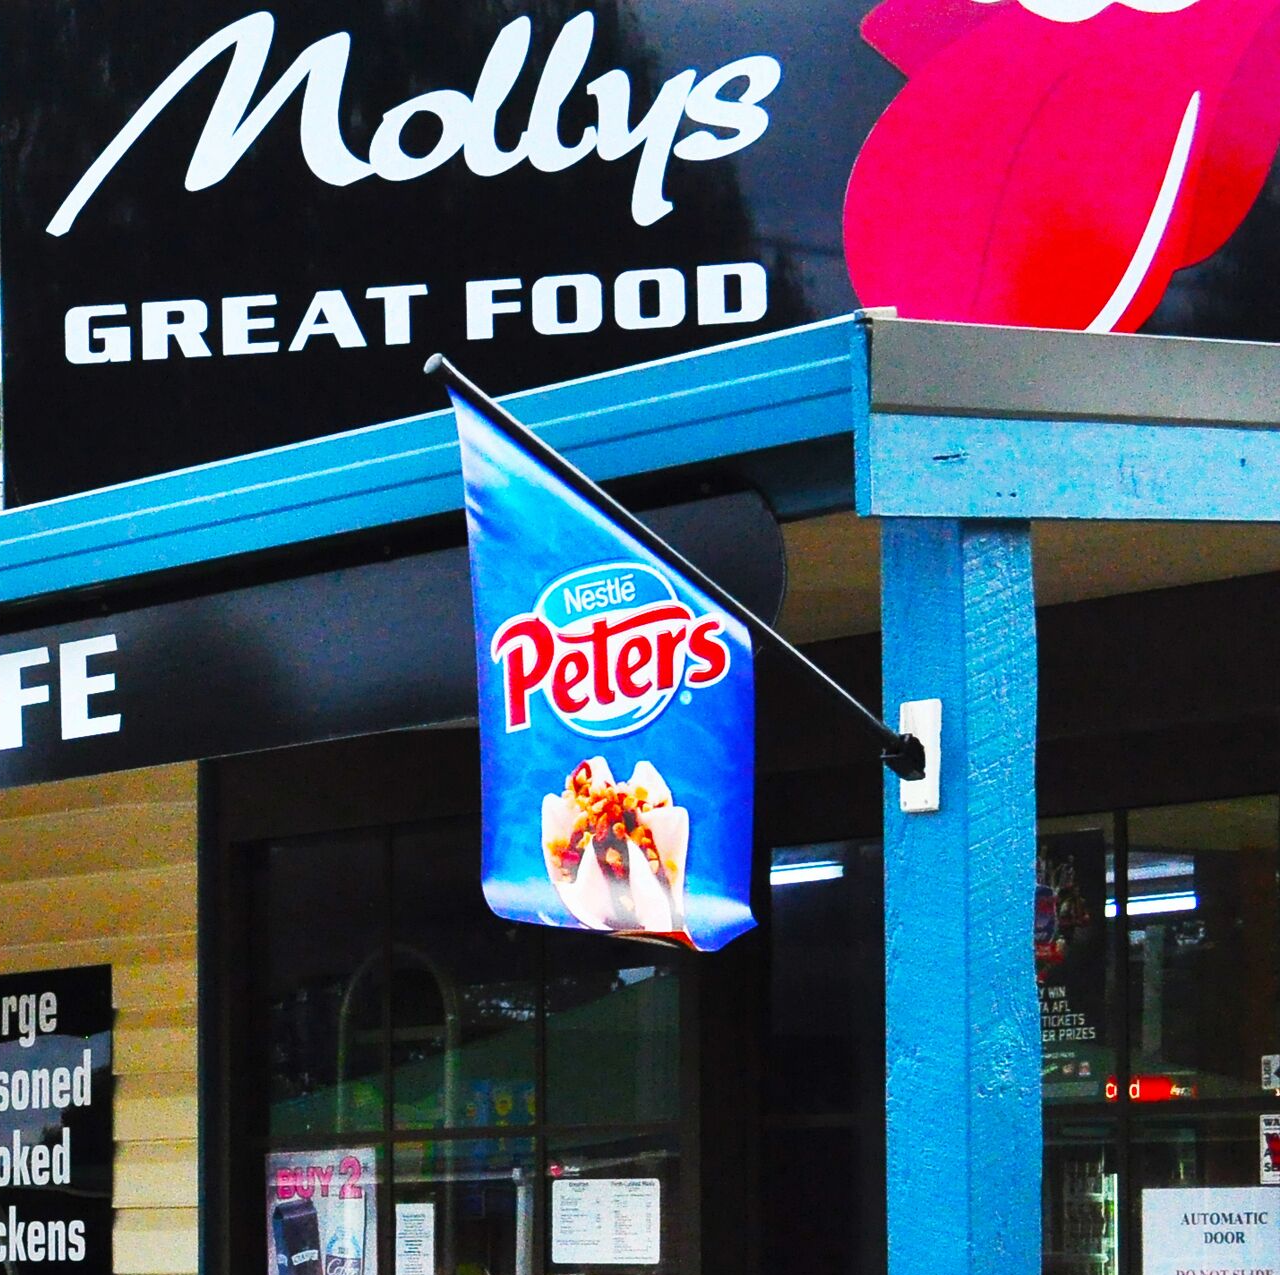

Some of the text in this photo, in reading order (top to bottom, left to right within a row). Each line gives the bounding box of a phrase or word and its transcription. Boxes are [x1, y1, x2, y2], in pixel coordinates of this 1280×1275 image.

[45, 10, 783, 238] Mollys
[64, 261, 769, 365] GREAT FOOD
[492, 603, 730, 732] Peters
[1048, 986, 1066, 998] WIN
[1052, 1000, 1071, 1012] AFL
[1041, 1013, 1085, 1027] TICKETS
[1059, 1027, 1096, 1040] PRIZES
[275, 1165, 335, 1200] BUY
[1180, 1211, 1269, 1226] AUTOMATIC
[1203, 1231, 1246, 1245] DOOR
